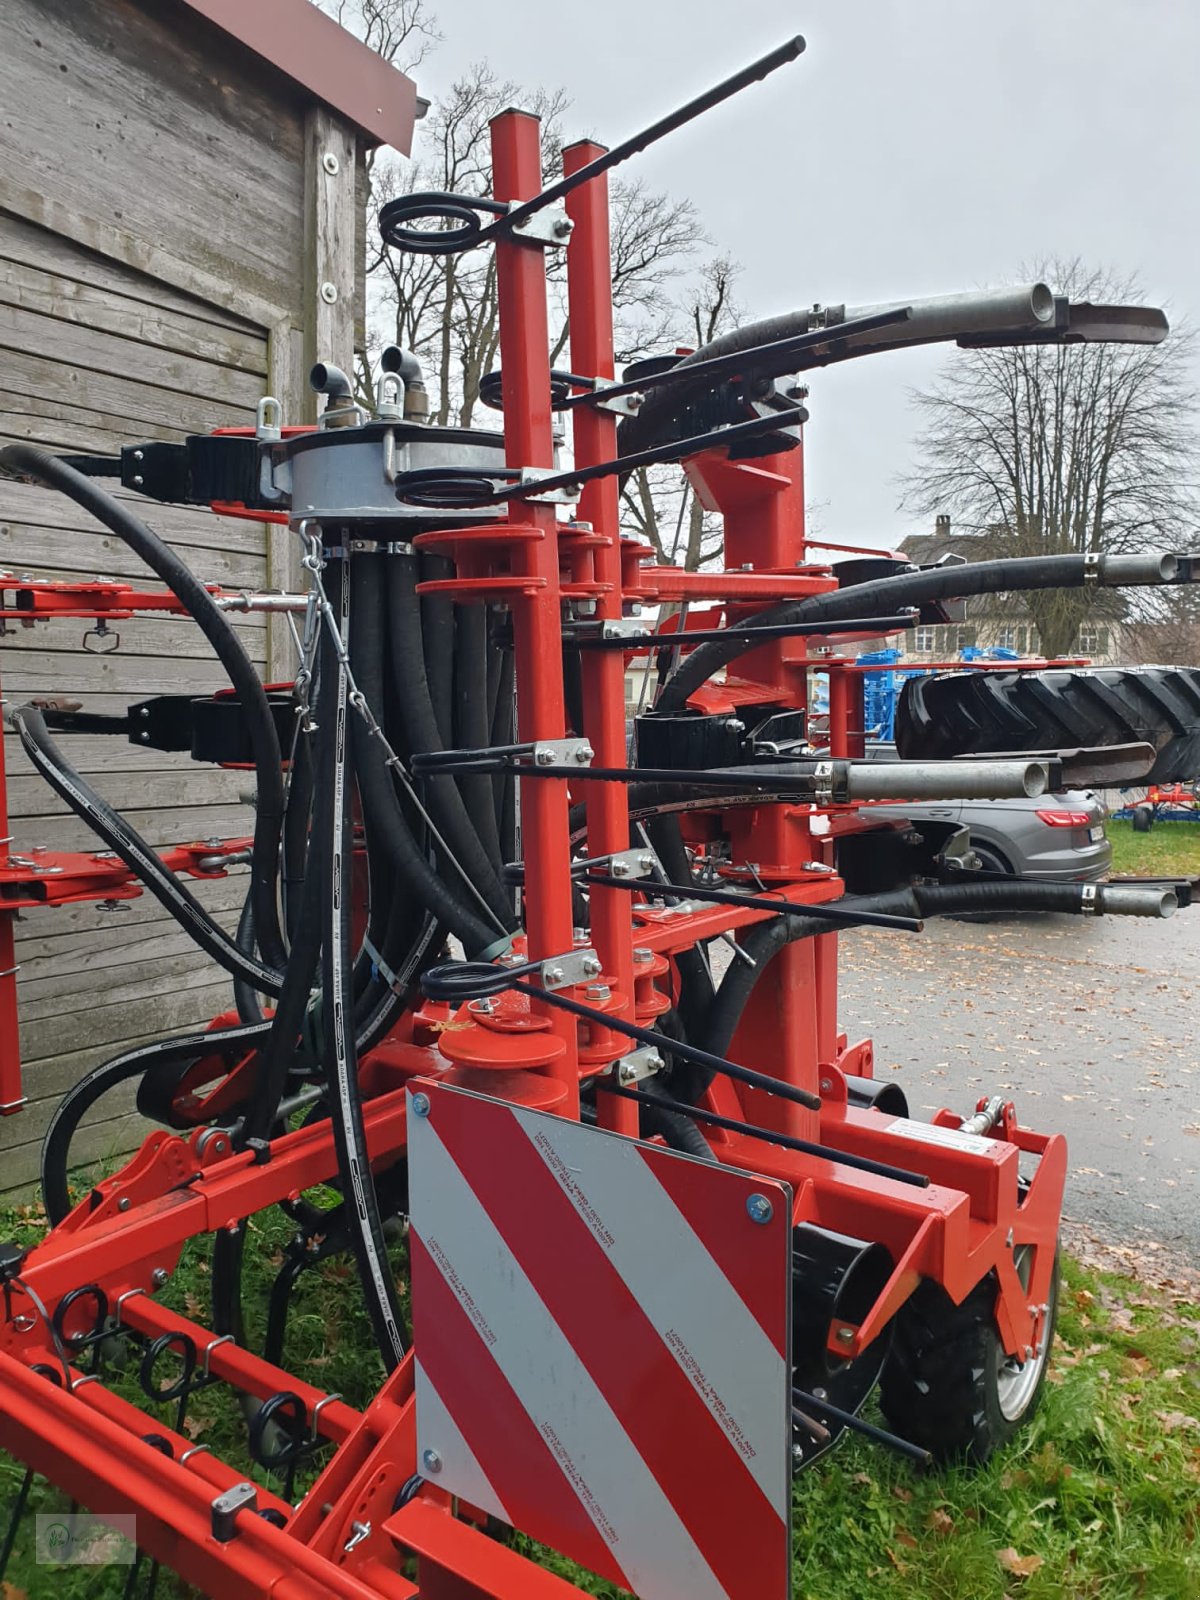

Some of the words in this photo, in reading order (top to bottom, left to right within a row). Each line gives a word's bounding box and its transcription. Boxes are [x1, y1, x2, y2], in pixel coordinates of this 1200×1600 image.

[543, 1149, 557, 1169] 11030
[559, 1173, 574, 1194] GEKA
[573, 1184, 589, 1205] GEKA
[590, 1210, 605, 1229] 11030
[669, 1329, 690, 1357] A10071
[665, 1333, 676, 1347] DIN
[675, 1348, 691, 1370] 11030
[693, 1374, 710, 1398] GEKA
[730, 1431, 751, 1460] A10071
[709, 1388, 727, 1412] GEKA
[728, 1417, 745, 1440] 11030
[744, 1441, 756, 1457] DIN
